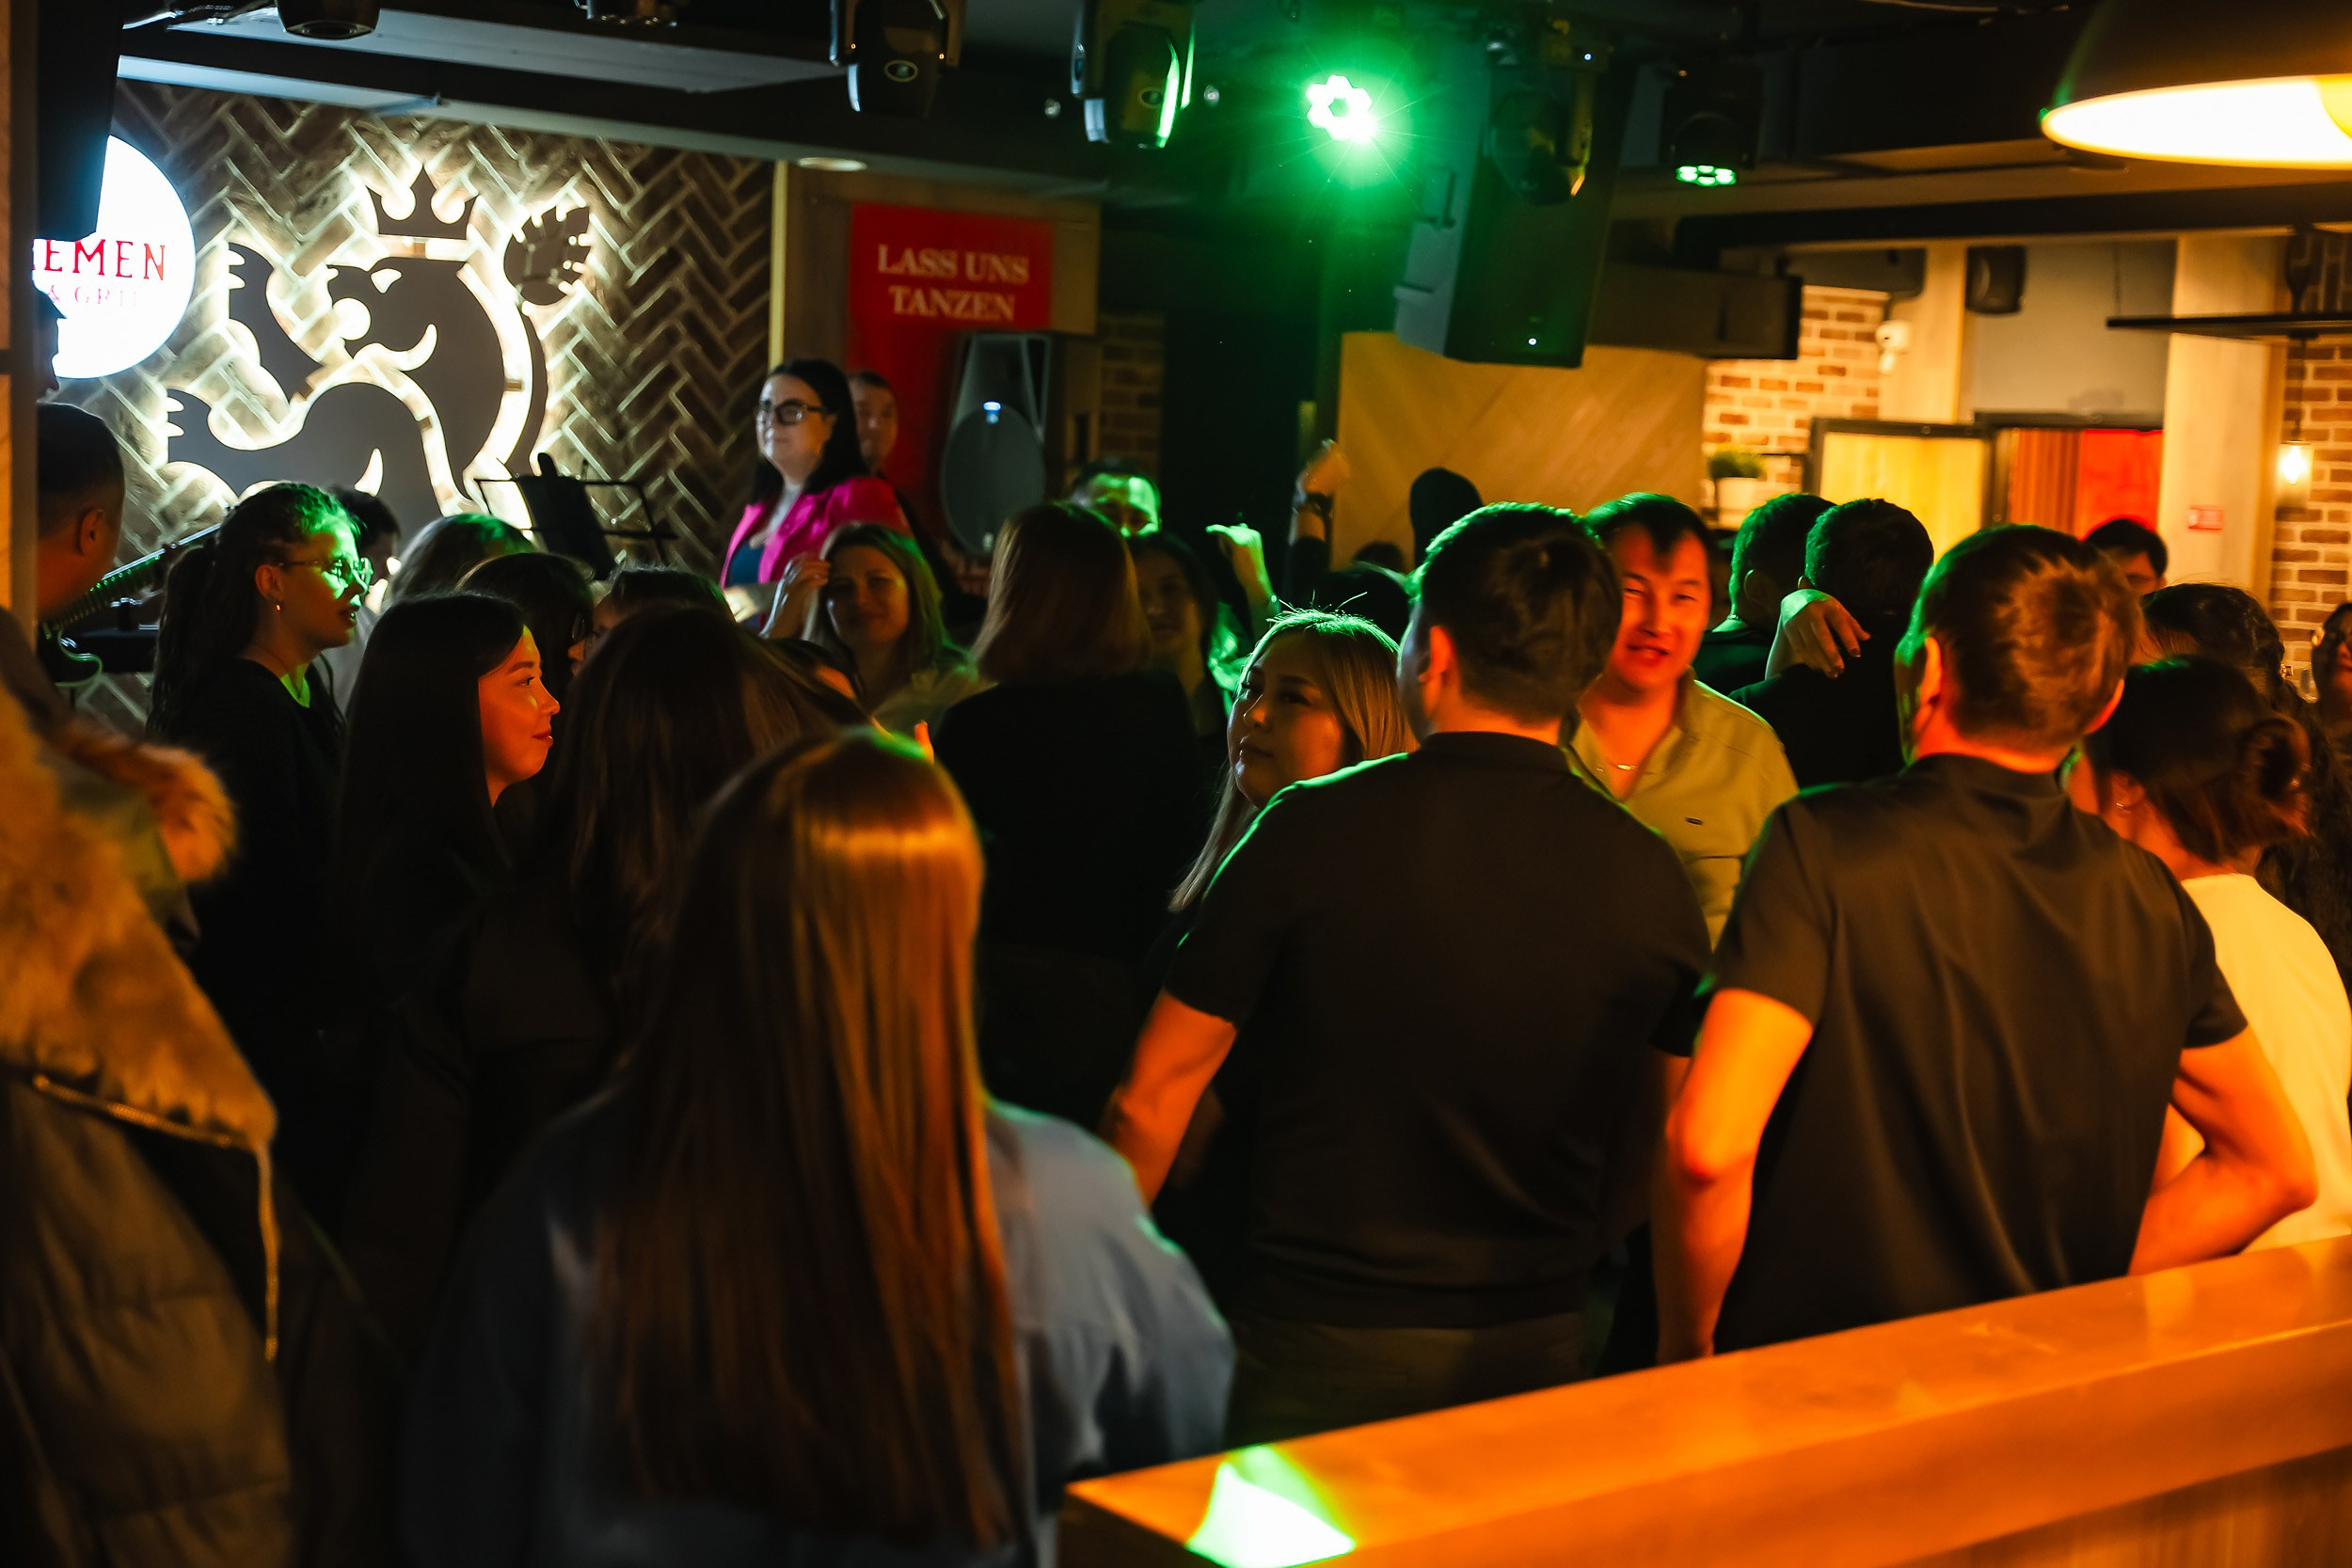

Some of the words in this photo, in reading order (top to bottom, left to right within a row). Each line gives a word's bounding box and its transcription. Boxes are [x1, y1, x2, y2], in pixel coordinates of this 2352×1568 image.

[32, 239, 166, 281] EMEN
[878, 244, 957, 279] LASS
[964, 250, 1029, 285] UNS
[888, 284, 1015, 322] TANZEN
